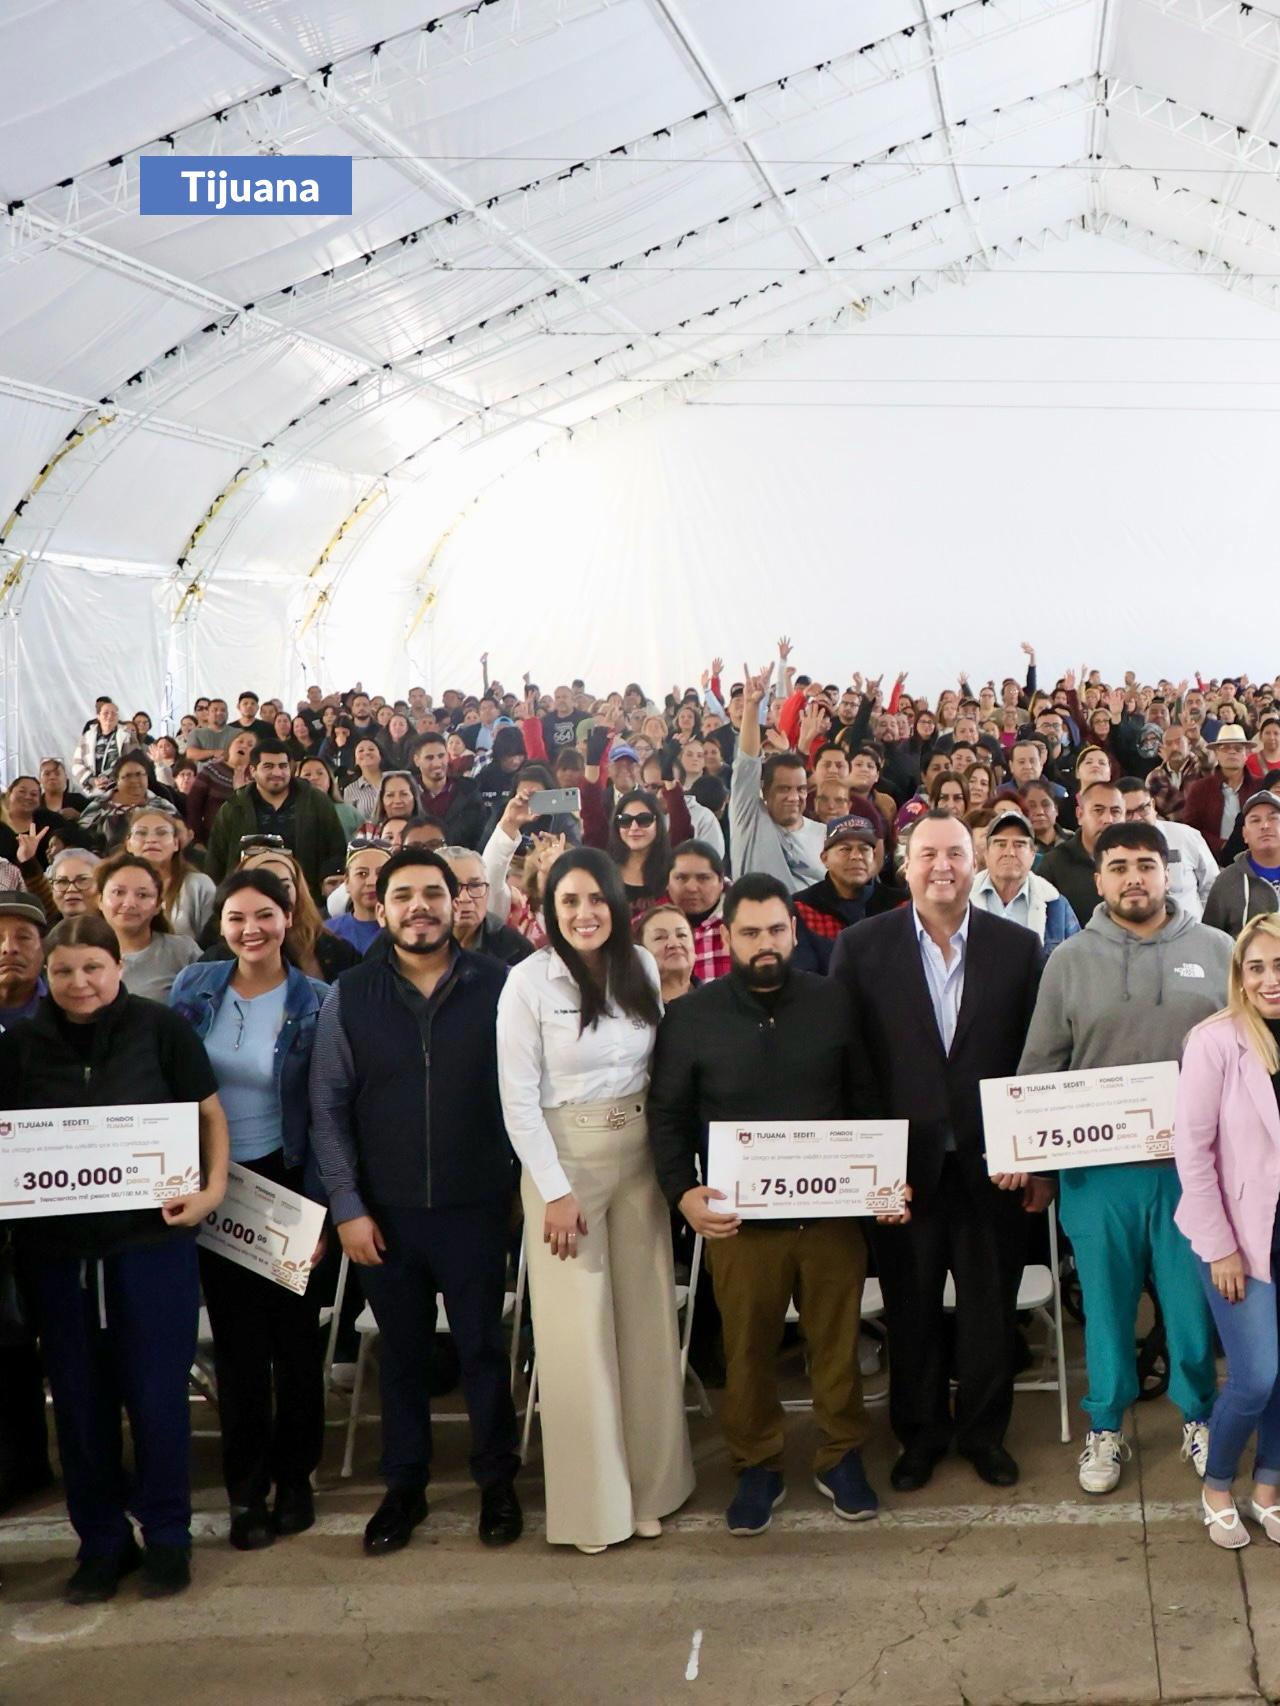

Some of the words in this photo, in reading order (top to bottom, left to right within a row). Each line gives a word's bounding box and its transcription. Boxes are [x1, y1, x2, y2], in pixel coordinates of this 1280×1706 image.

[1026, 1084, 1056, 1092] TIJUANA
[17, 1120, 54, 1129] TIJUANA
[62, 1119, 90, 1127] SEDETI
[1037, 1124, 1113, 1148] 75,000
[1116, 1122, 1127, 1130] 00
[23, 1167, 122, 1190] 300,000
[126, 1166, 139, 1174] 00
[760, 1177, 837, 1198] 75,000
[206, 1211, 255, 1244] 0,000
